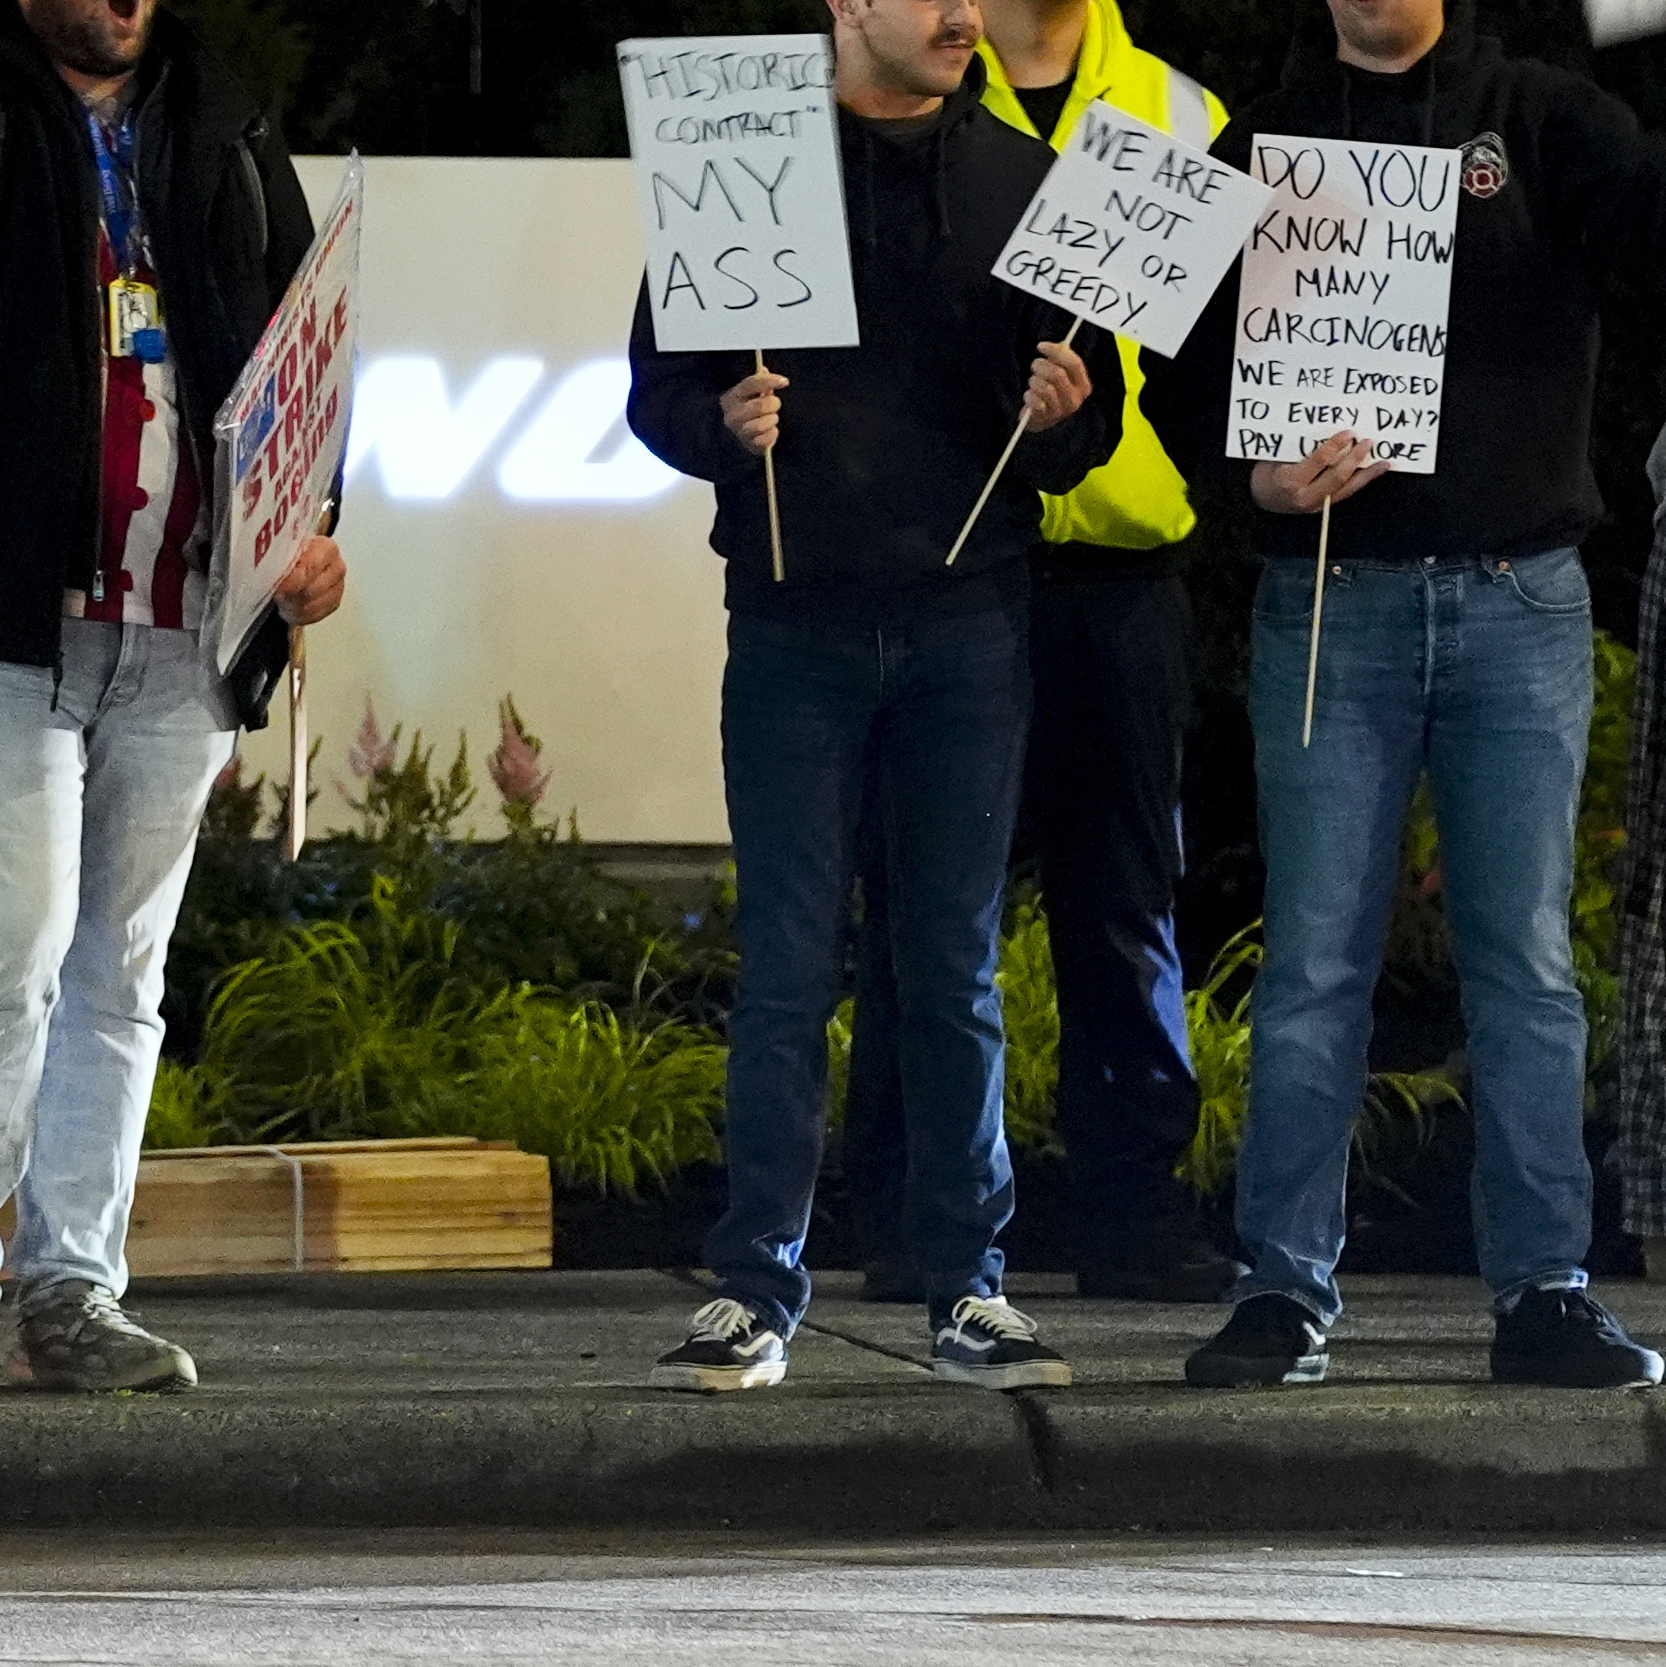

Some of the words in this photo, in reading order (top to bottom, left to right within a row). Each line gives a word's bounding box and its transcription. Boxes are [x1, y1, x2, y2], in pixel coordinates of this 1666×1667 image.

[1081, 111, 1151, 172] WE
[1152, 148, 1233, 205] ARE
[1257, 145, 1325, 200] DO
[1349, 148, 1450, 212] YOU
[651, 156, 794, 230] MY
[1104, 189, 1193, 240] NOT
[1025, 198, 1127, 268] LAZY
[1141, 254, 1188, 294] OR
[1252, 209, 1368, 257] KNOW
[1387, 220, 1455, 264] HOW
[662, 246, 813, 311] ASS
[1295, 264, 1391, 305] MANY
[277, 295, 317, 407] ON
[1243, 306, 1447, 357] CARCINOGENS
[242, 284, 347, 523] STRIKE
[1237, 358, 1285, 386] WE
[1296, 367, 1334, 388] ARE
[1343, 368, 1438, 395] EXPOSED
[1236, 398, 1270, 421] TO
[1288, 401, 1359, 426] EVERY
[1376, 405, 1440, 432] DAY?
[1239, 428, 1283, 458] PAY
